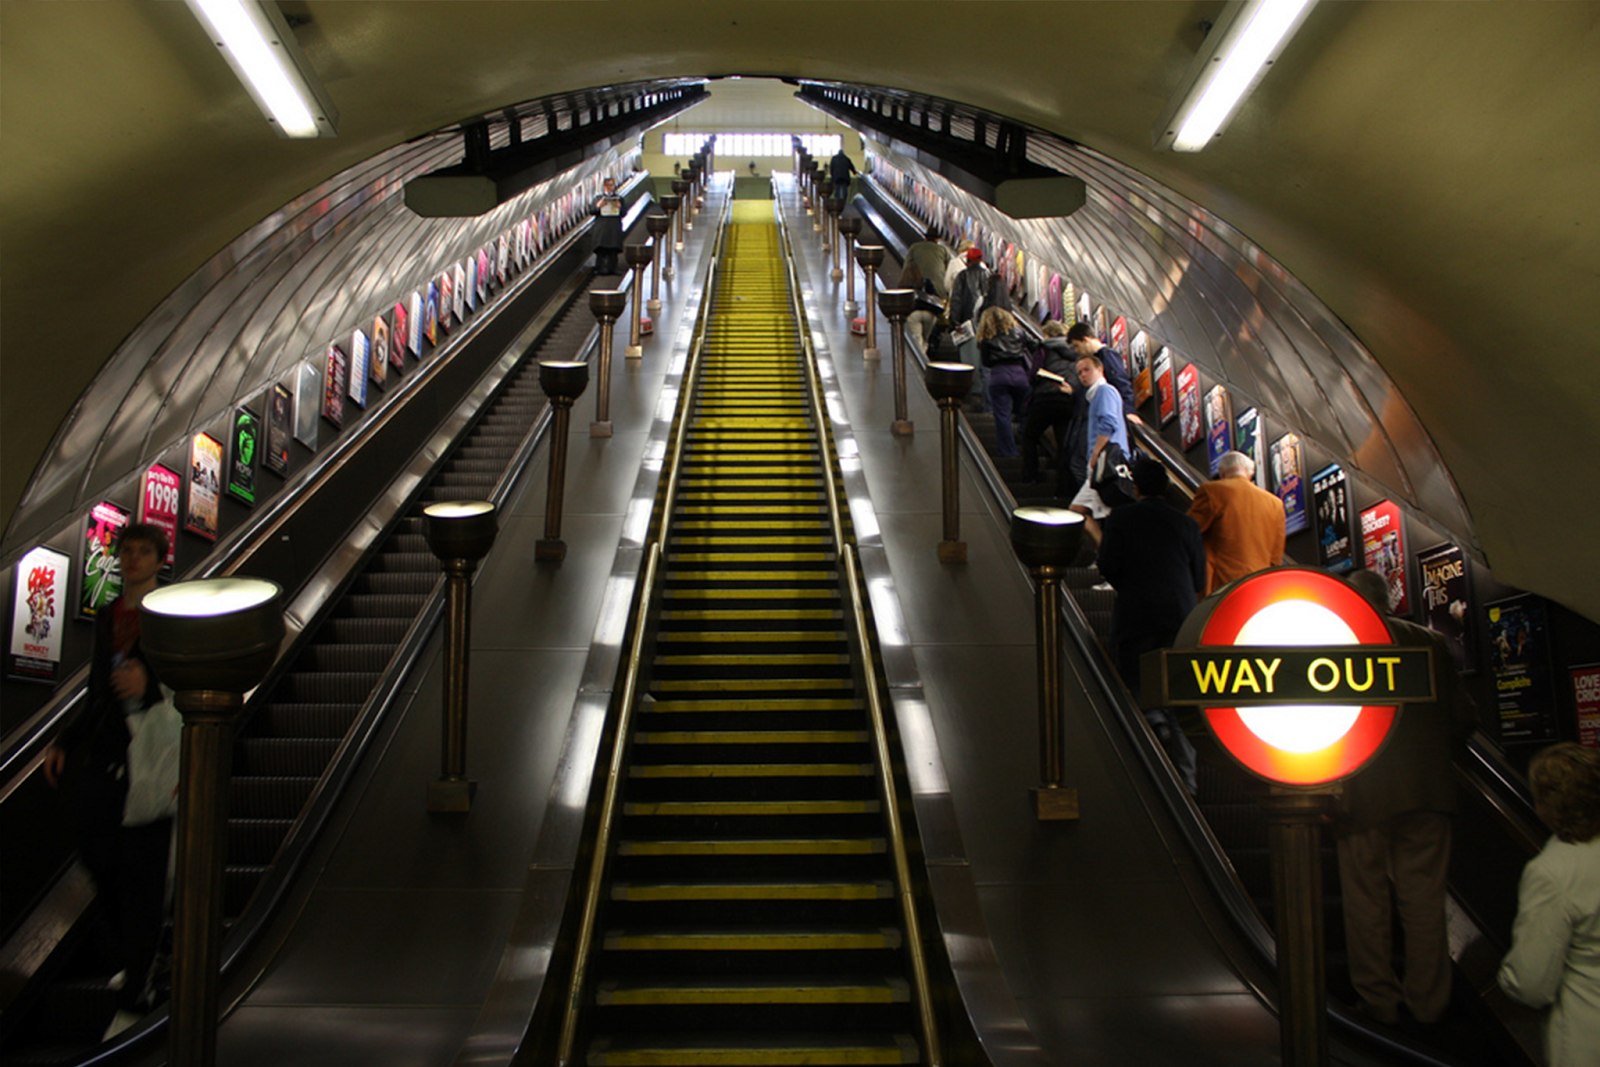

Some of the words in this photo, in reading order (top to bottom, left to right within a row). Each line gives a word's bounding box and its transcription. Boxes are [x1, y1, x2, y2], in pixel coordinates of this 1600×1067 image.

[147, 481, 179, 515] 1998
[85, 546, 122, 608] Cage
[1190, 658, 1282, 694] WAY
[1307, 657, 1401, 692] OUT
[1574, 673, 1600, 689] LOVE
